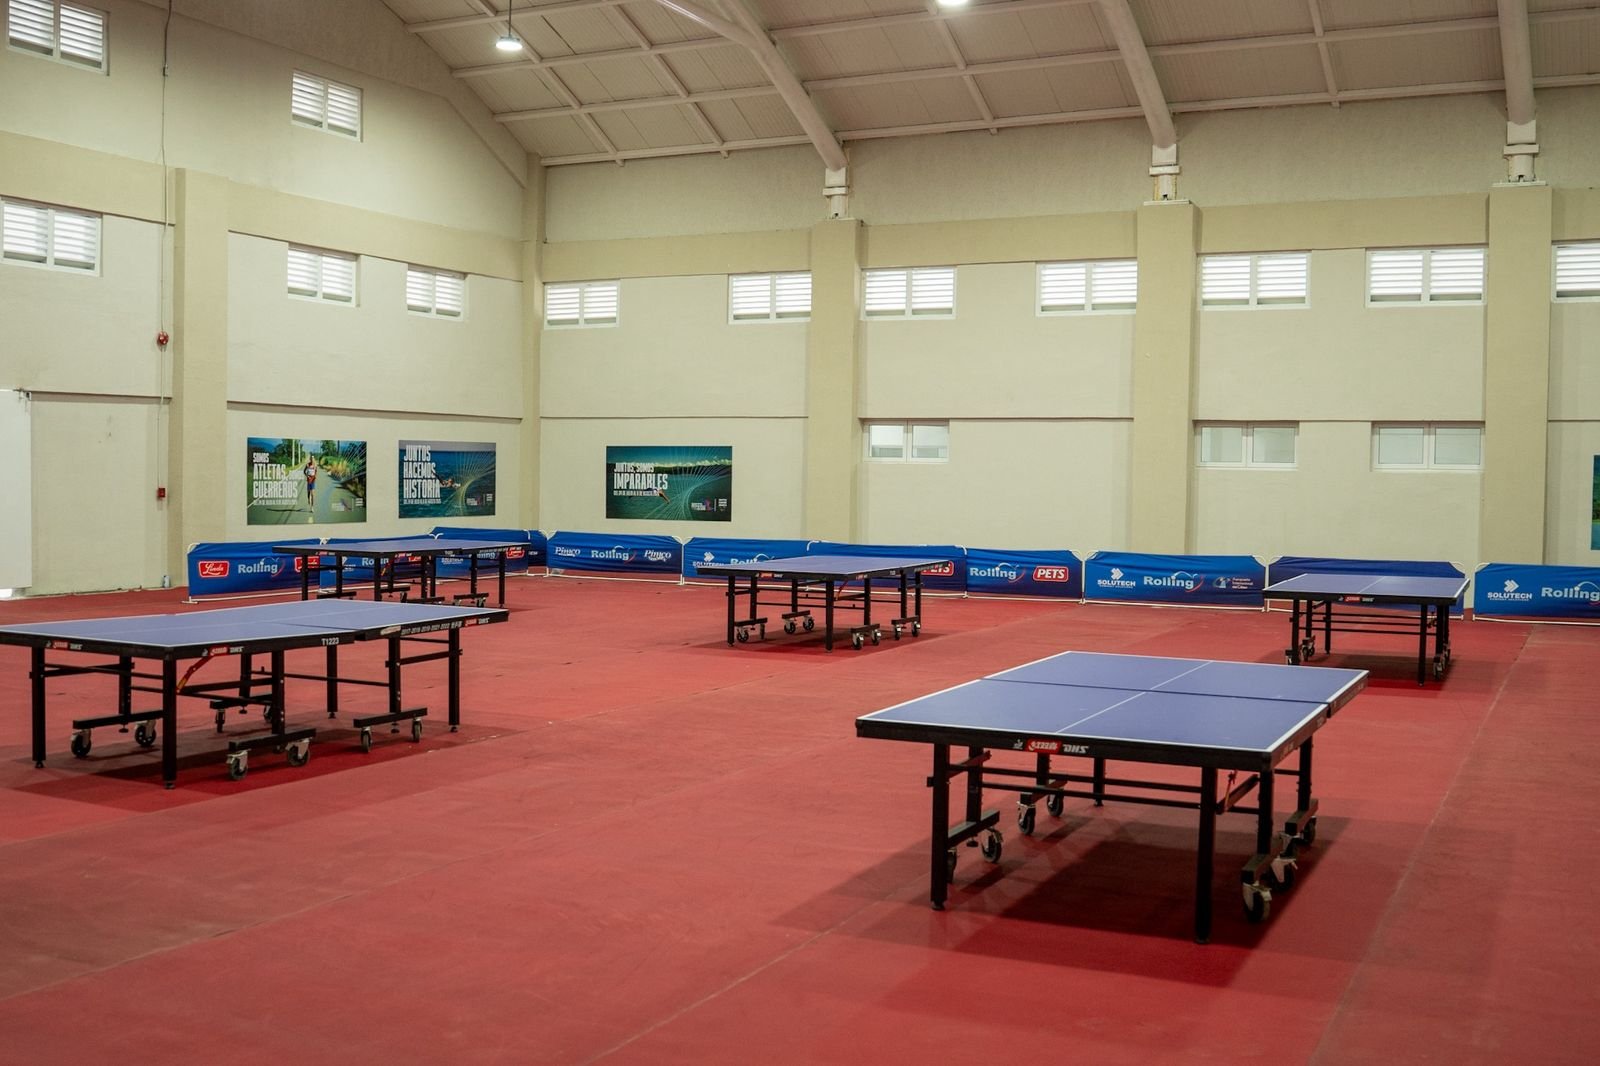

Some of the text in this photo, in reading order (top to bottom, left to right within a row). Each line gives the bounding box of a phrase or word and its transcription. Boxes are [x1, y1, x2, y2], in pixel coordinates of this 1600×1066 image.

[403, 445, 431, 461] JUNTOS
[403, 462, 437, 478] HACEMOS
[403, 479, 441, 499] HISTORIA
[613, 473, 668, 490] IMPARABLES
[253, 481, 299, 499] GUERREROS
[591, 549, 630, 561] Rolling
[237, 560, 279, 574] Rolling
[969, 566, 1065, 580] Rolling PETS
[1097, 575, 1194, 590] SOLUTECH Rolling
[1487, 586, 1600, 602] SOLUTECH Rolling
[321, 637, 339, 646] T1223
[1062, 743, 1090, 754] DHS
